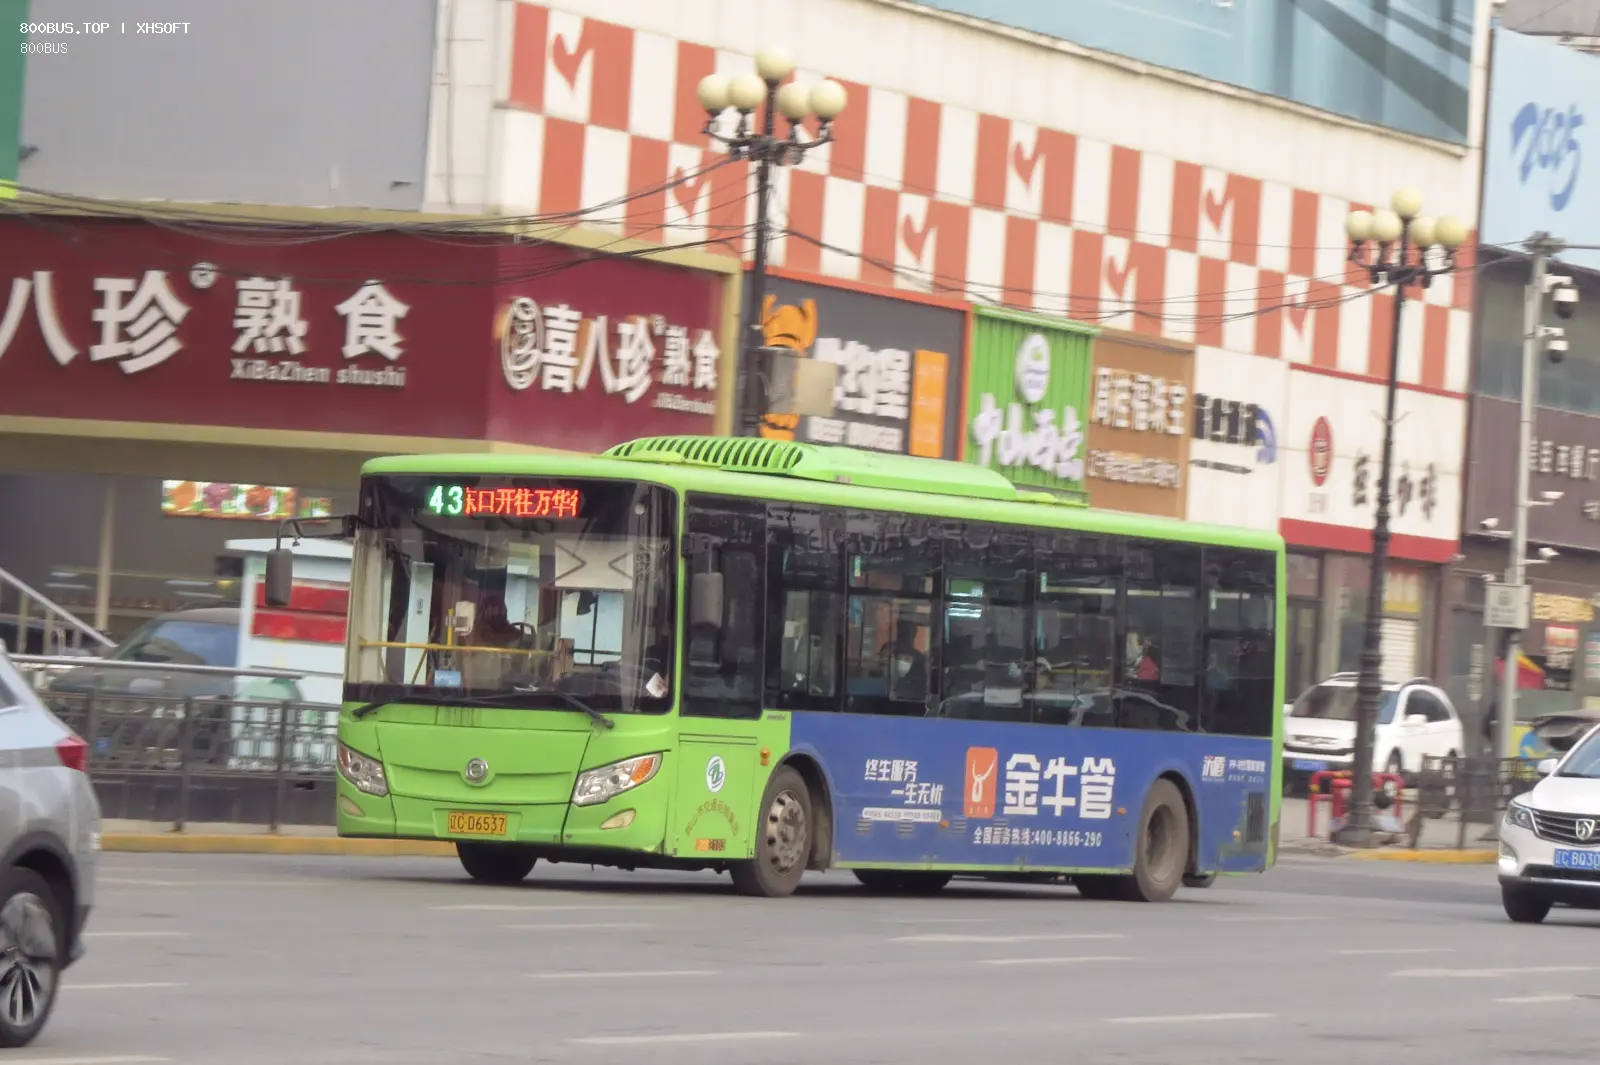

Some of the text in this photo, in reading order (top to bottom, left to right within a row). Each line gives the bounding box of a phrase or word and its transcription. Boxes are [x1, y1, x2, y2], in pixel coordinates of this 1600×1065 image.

[231, 276, 410, 361] 熟食
[541, 303, 656, 404] 喜八珍
[660, 325, 721, 390] 熟食
[335, 364, 406, 387] shushi
[428, 485, 464, 515] 43
[863, 759, 918, 782] 终生服务
[891, 783, 944, 805] 一生无忧
[1003, 753, 1116, 819] 金牛管
